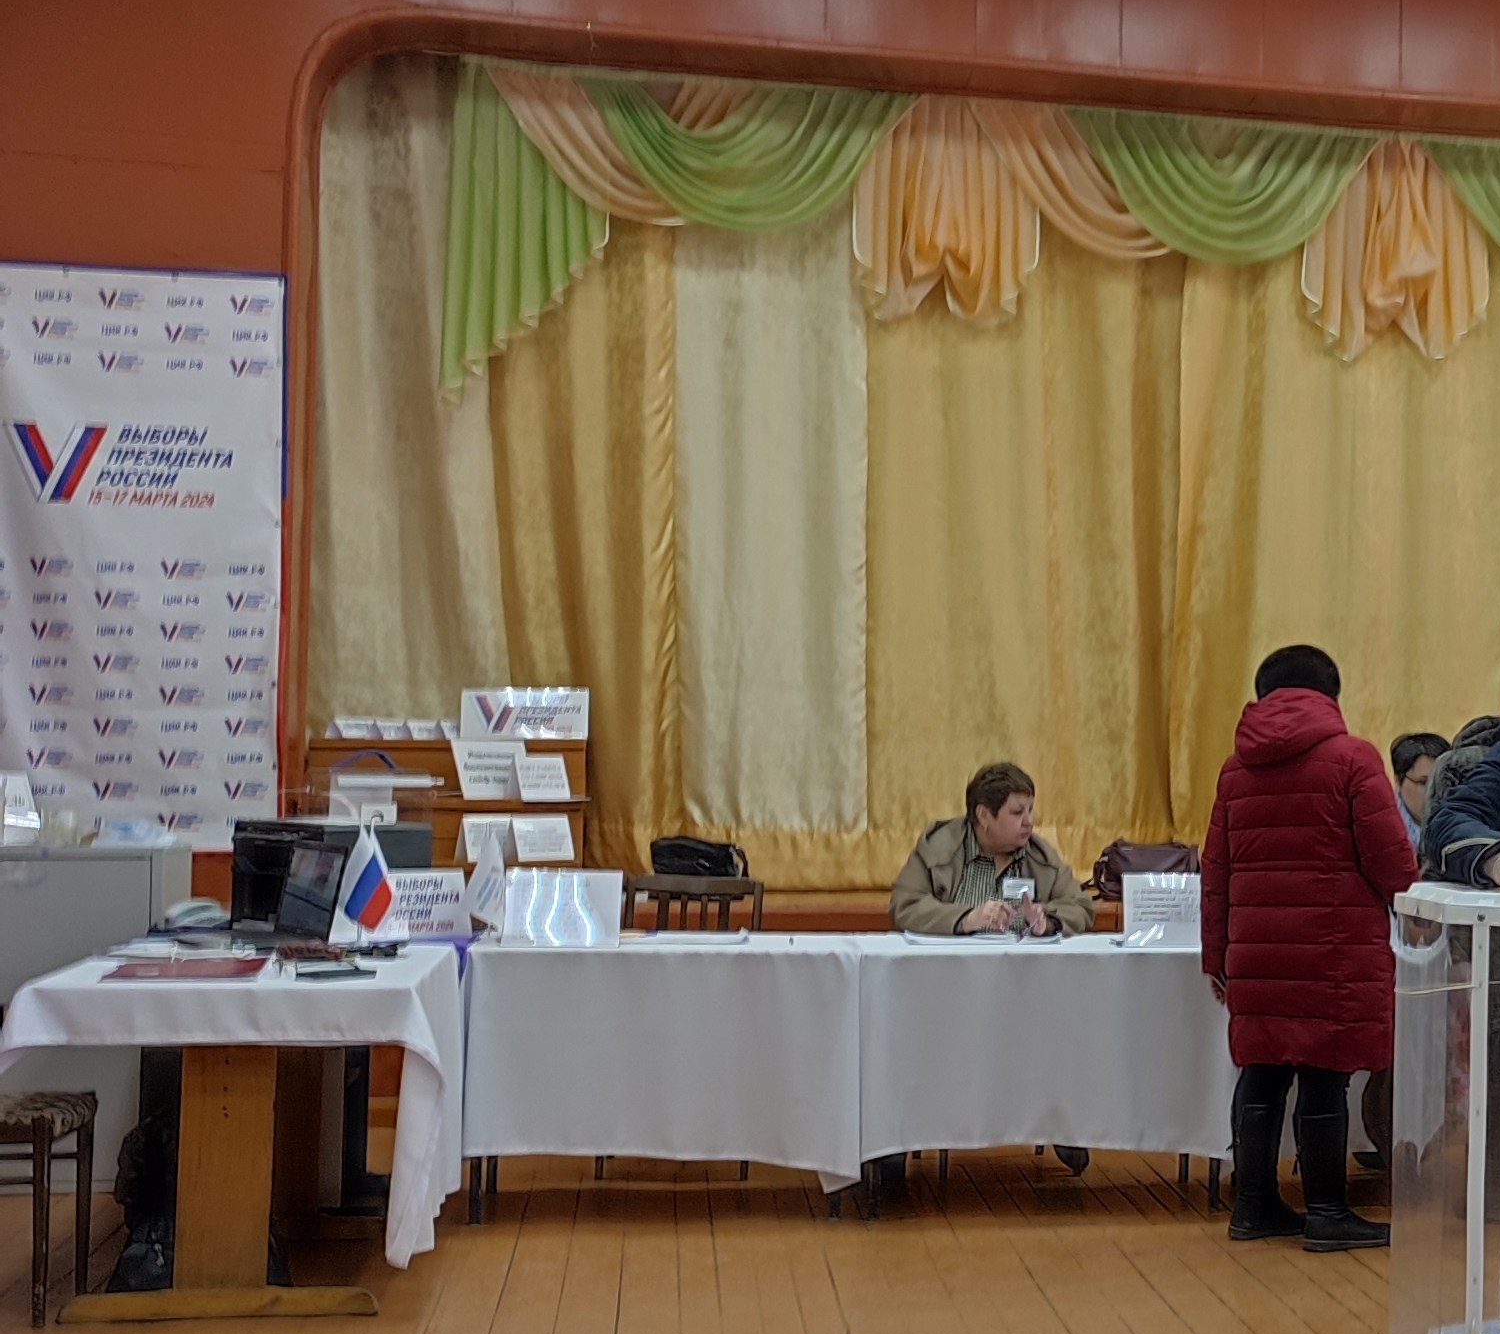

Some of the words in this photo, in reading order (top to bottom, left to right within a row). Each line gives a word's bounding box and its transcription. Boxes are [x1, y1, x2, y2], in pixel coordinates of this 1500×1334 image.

[117, 424, 208, 446] ВЫБОРЫ
[107, 447, 234, 470] ПРЕЗИДЕНТА
[95, 469, 180, 489] РОССИИ
[128, 492, 178, 507] МАРТА
[180, 492, 216, 509] 2024
[399, 890, 460, 906] РЕЗИДЕНТА
[394, 908, 432, 921] ОССИИ
